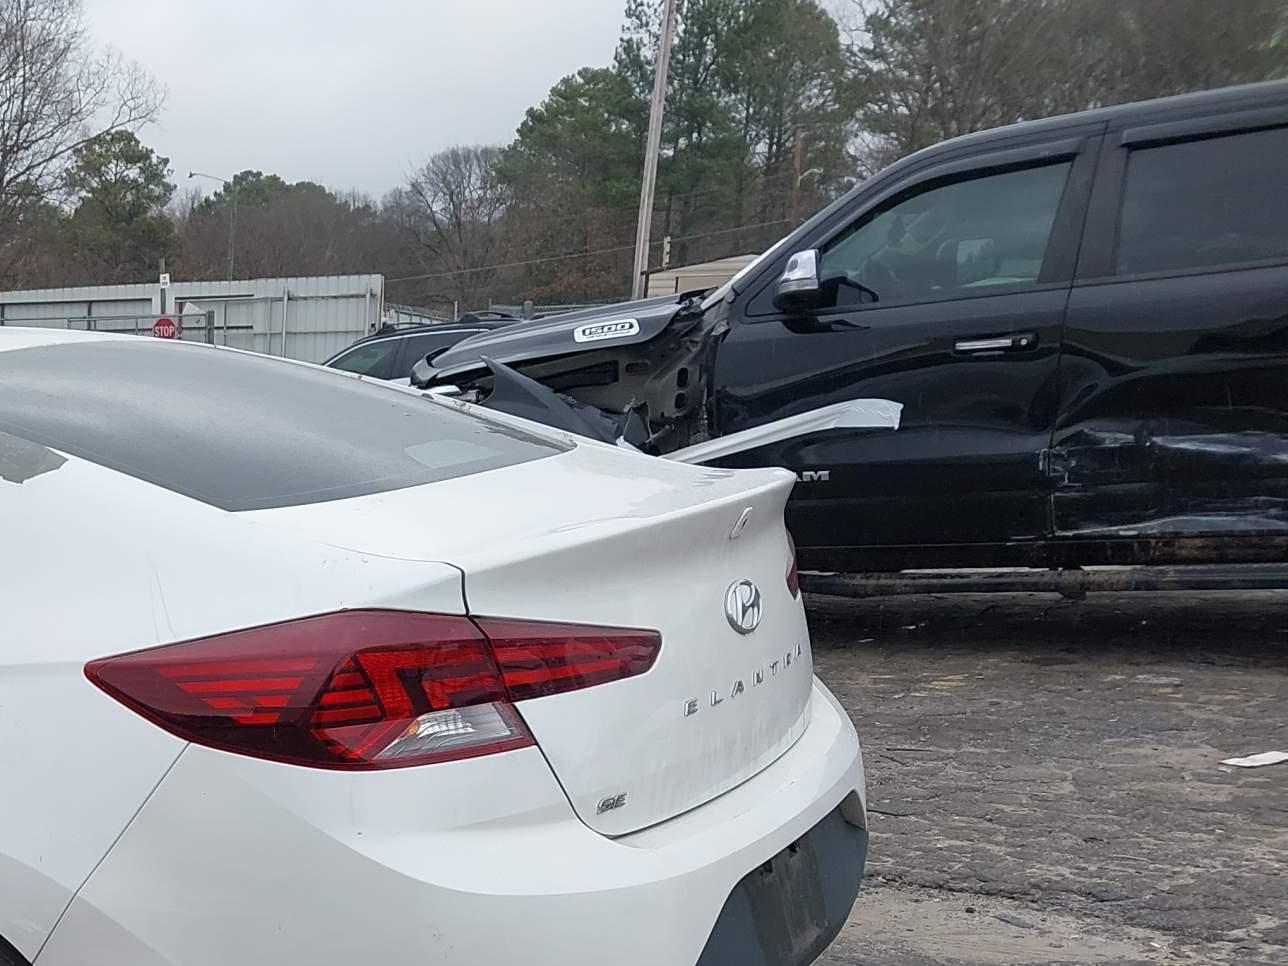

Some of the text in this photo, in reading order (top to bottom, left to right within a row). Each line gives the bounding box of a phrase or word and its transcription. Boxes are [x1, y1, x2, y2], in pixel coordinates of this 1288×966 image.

[154, 325, 175, 337] STOP
[584, 322, 632, 336] 1500
[684, 643, 801, 717] ELANTRA
[597, 793, 627, 814] SE
